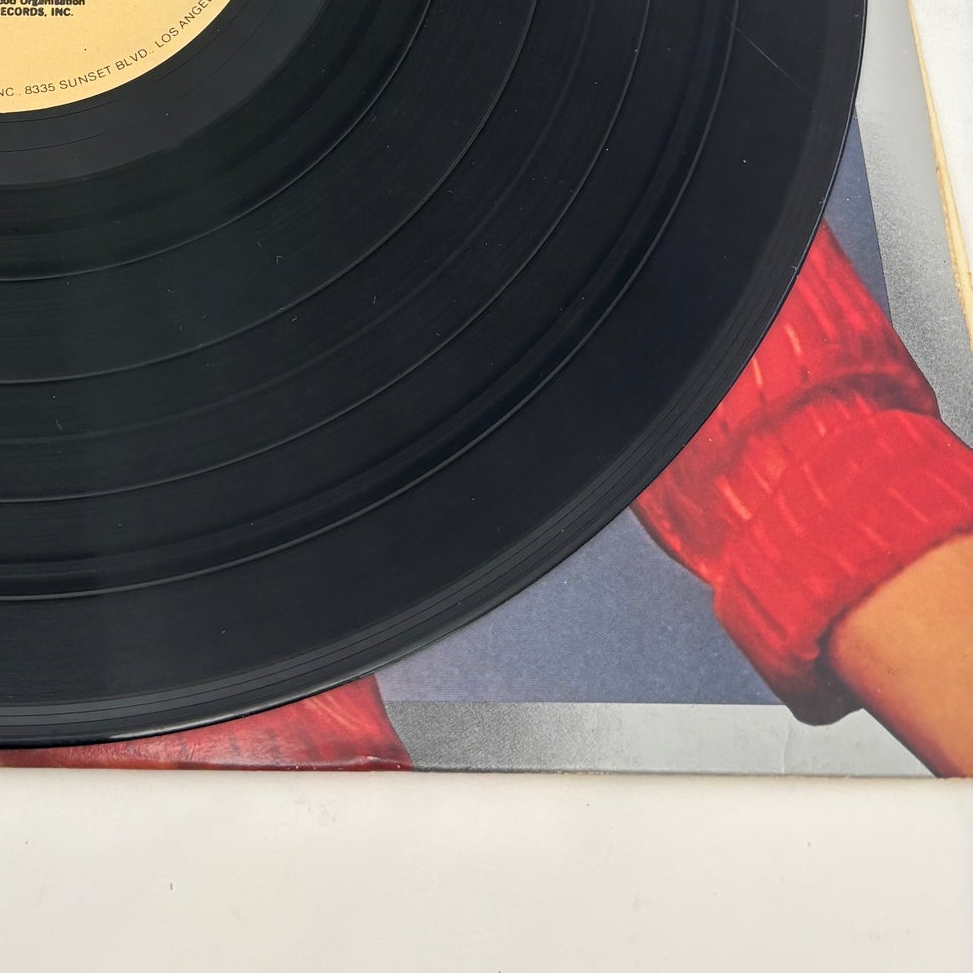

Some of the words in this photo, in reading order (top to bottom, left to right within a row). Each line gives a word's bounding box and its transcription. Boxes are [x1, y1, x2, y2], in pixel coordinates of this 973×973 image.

[51, 8, 74, 16] INC.
[24, 83, 56, 95] 8335
[59, 65, 113, 90] SUNSET
[154, 27, 179, 48] LOS
